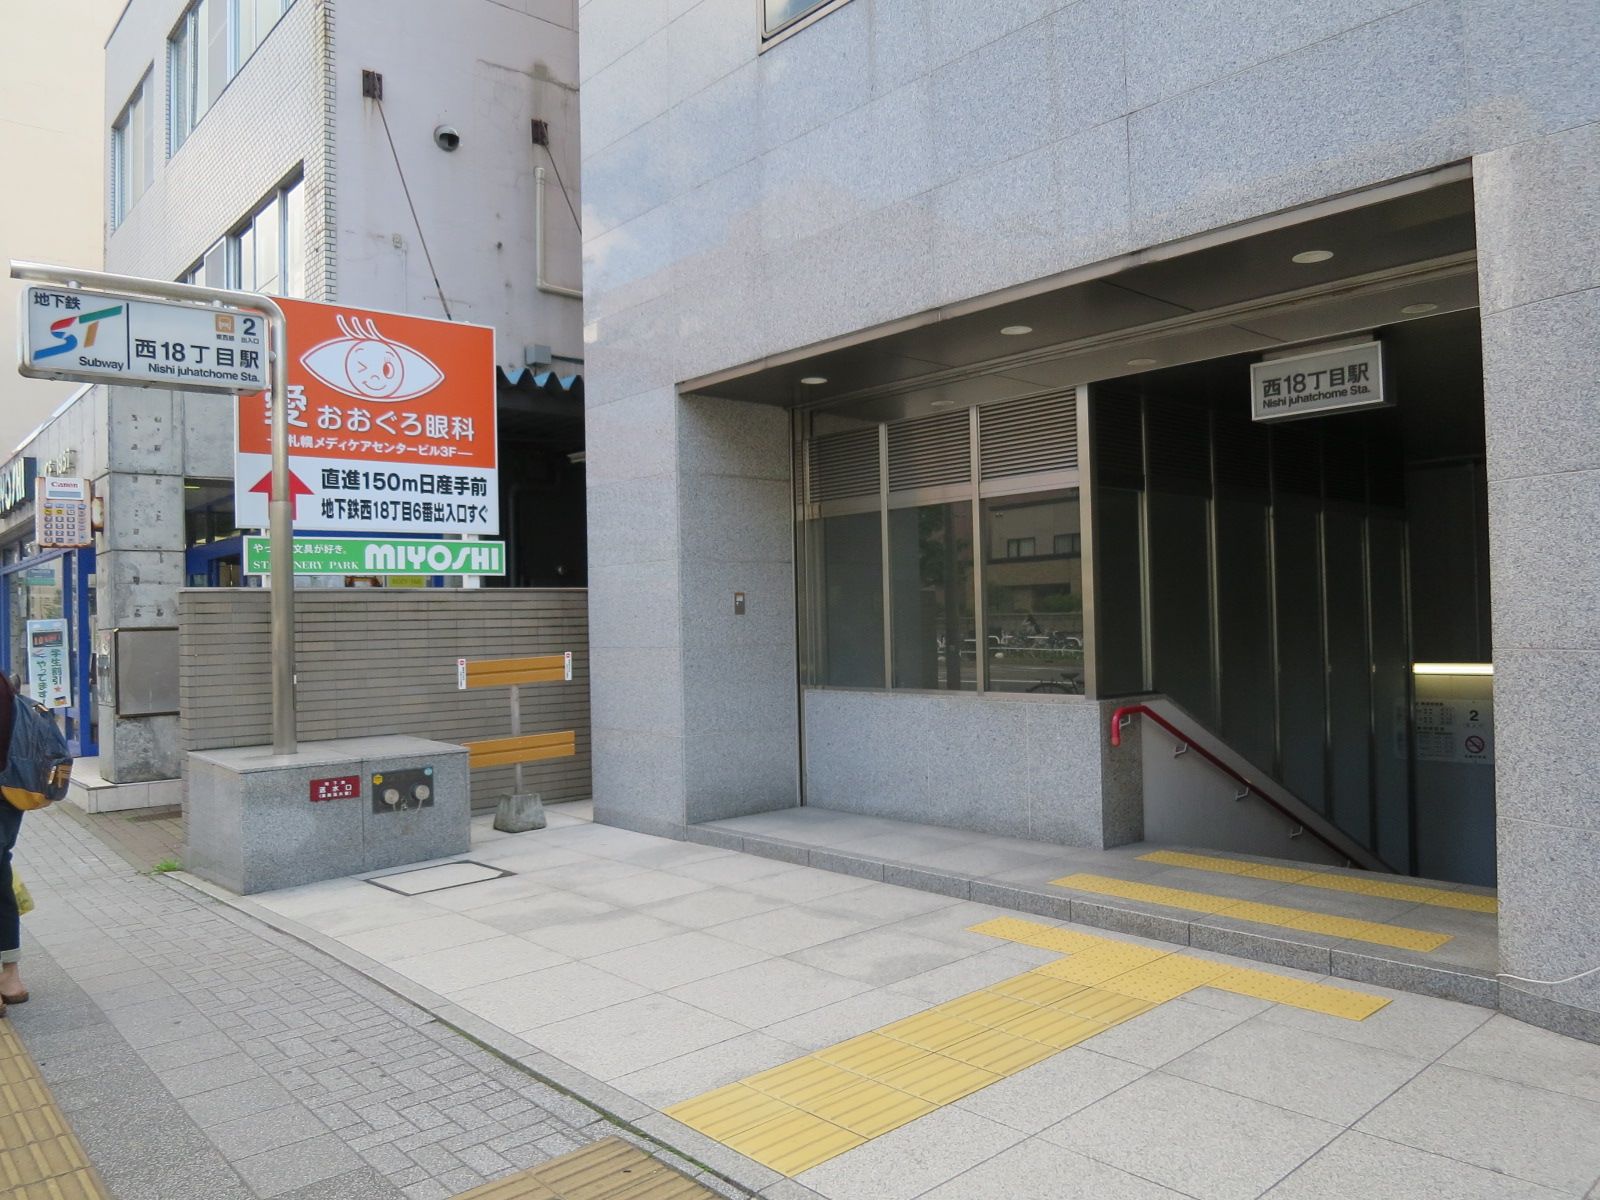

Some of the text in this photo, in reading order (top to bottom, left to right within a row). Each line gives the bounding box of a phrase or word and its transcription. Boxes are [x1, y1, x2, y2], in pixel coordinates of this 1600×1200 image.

[34, 292, 81, 310] 地下鉄
[243, 318, 256, 336] 2
[241, 337, 259, 345] 出入口
[135, 338, 259, 369] 西18丁目駅
[79, 356, 124, 371] Subway
[149, 363, 260, 382] Nishi juhatchome Sta.
[1262, 362, 1369, 398] 西18丁目駅
[1263, 396, 1287, 409] Nishi
[1350, 384, 1371, 395] Sta.
[317, 405, 474, 442] おおぐろ眼科
[51, 481, 79, 489] Canon
[321, 468, 488, 497] 直進150m日産手前
[321, 497, 488, 524] 地下鉄西18丁目6番出入口すぐ
[329, 560, 360, 570] PARK
[365, 544, 499, 570] MIYOSHI
[1469, 709, 1479, 722] 2
